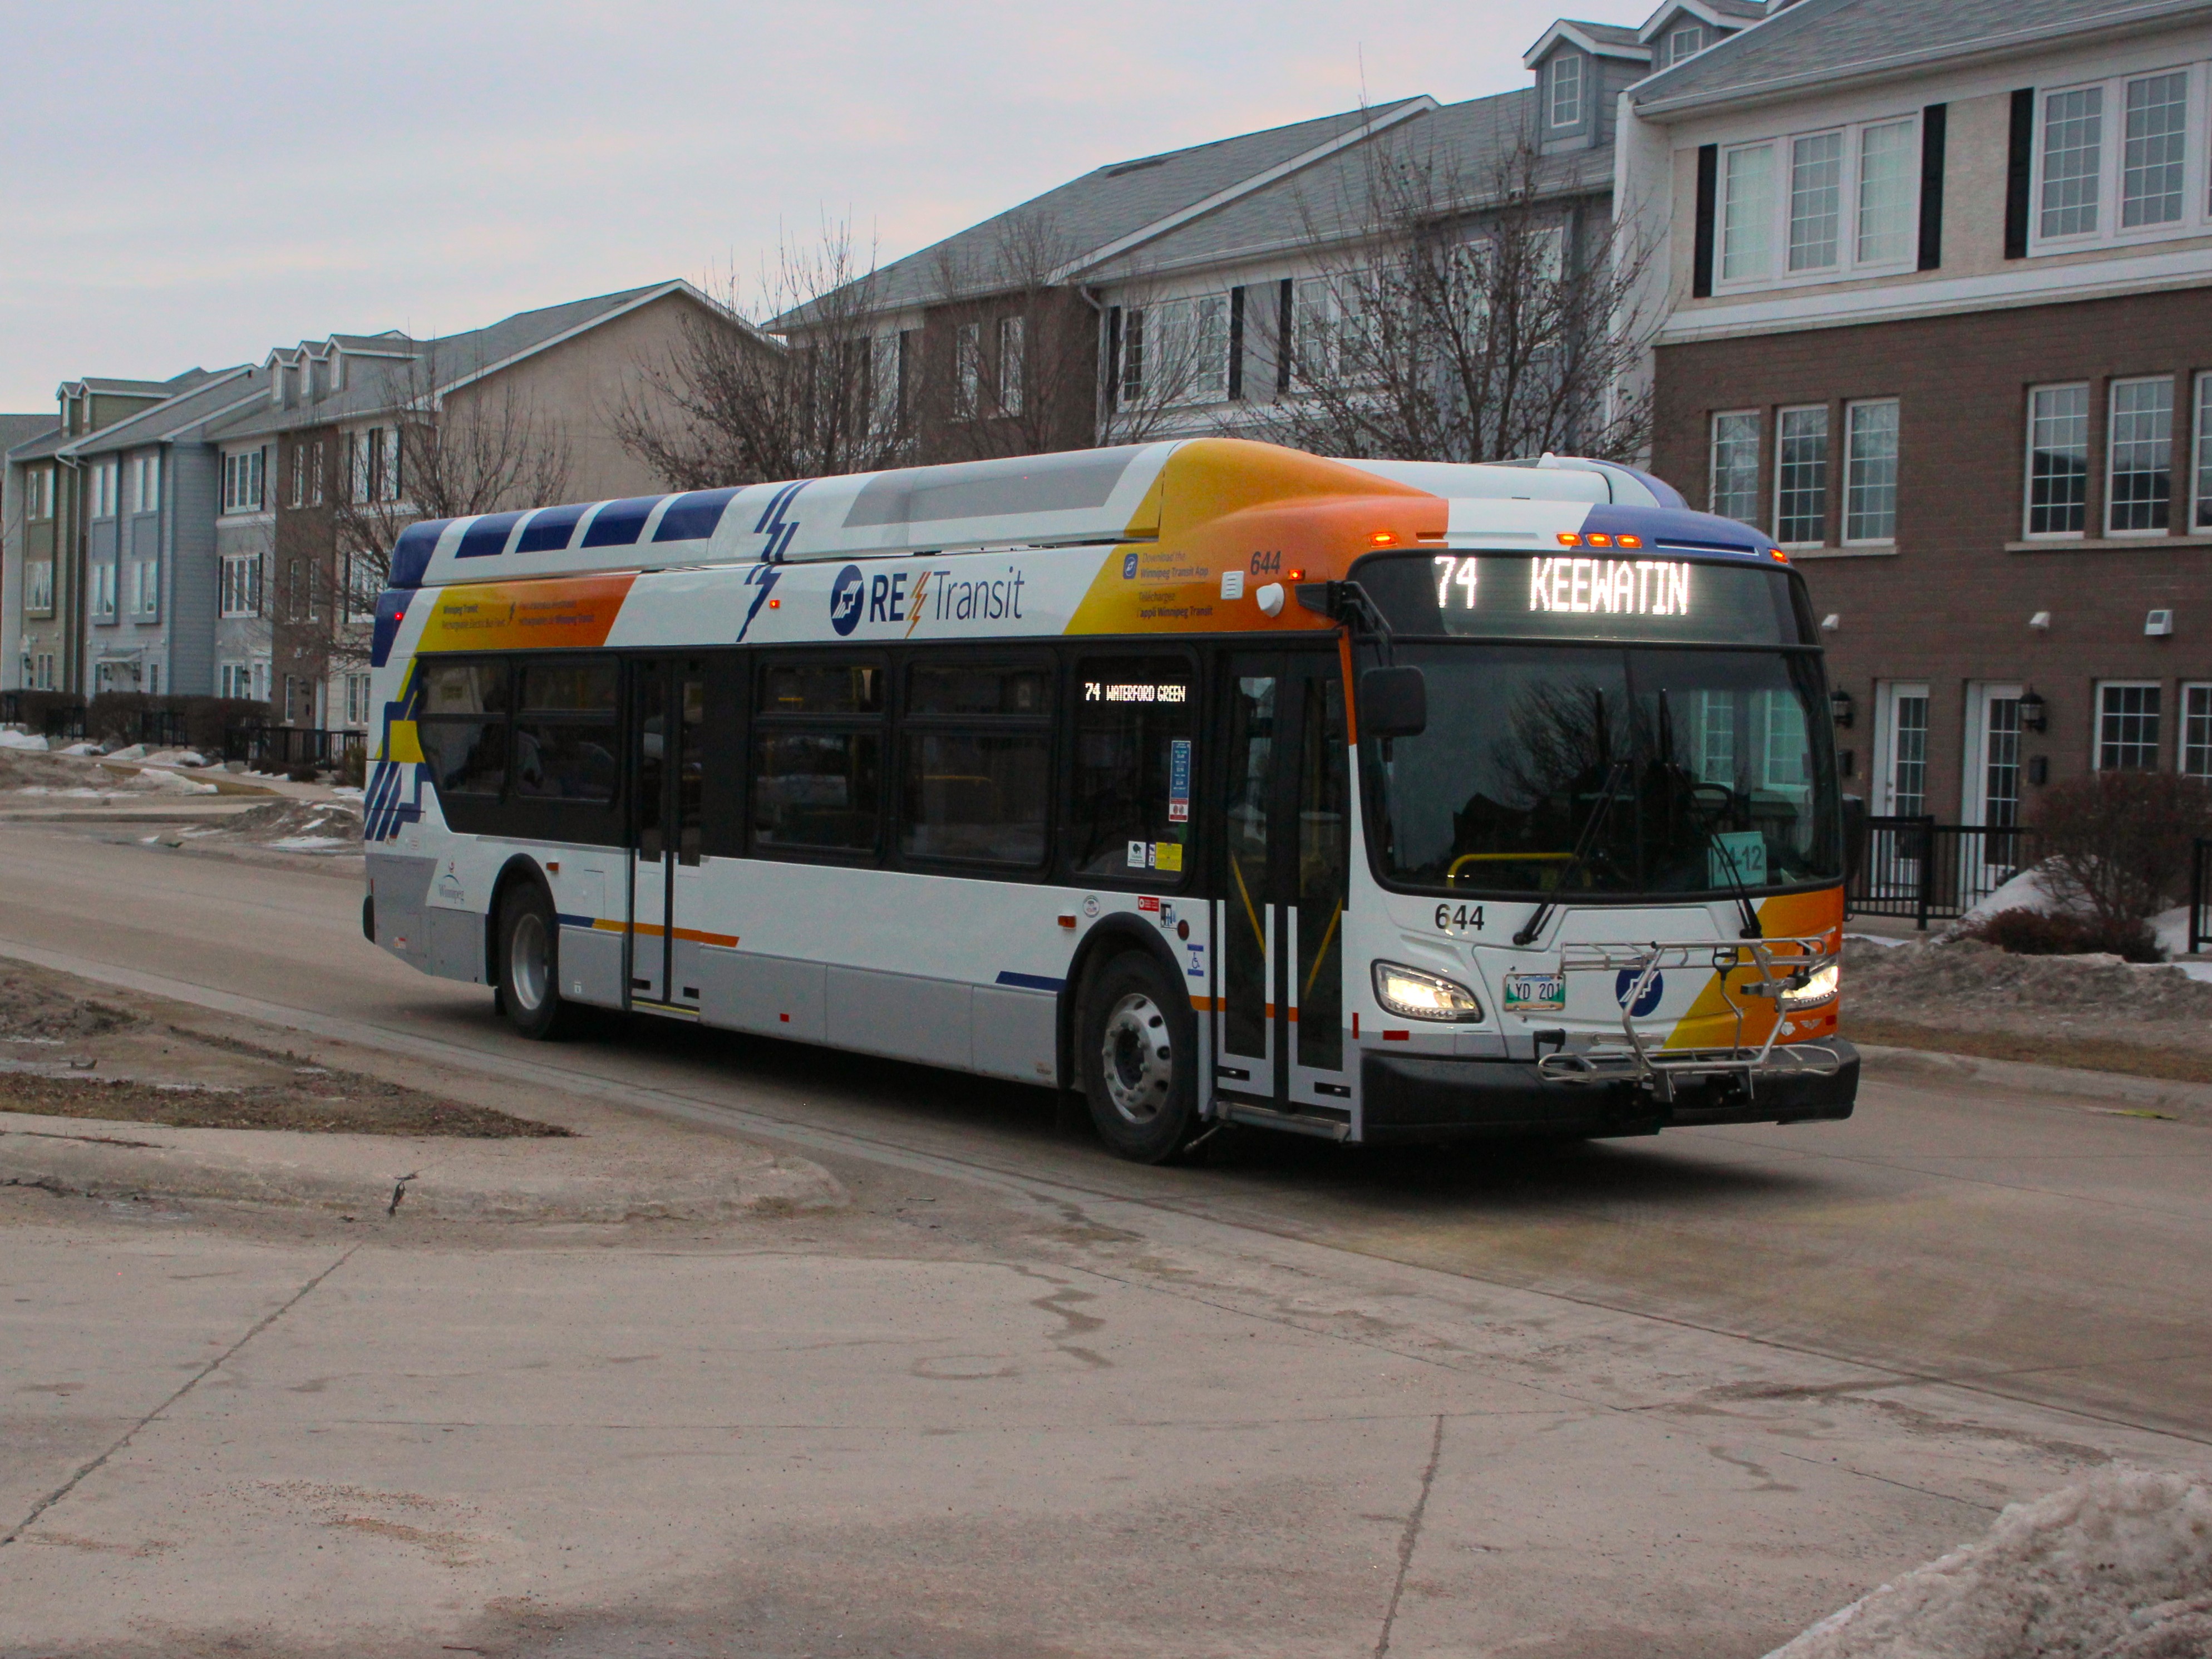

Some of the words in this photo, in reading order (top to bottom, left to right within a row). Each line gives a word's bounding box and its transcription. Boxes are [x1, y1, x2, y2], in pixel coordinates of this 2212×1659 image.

[1140, 568, 1170, 580] Winnipeg
[1171, 566, 1194, 577] Transit
[1195, 566, 1209, 578] App
[1250, 550, 1282, 575] 644
[869, 573, 908, 623] RE
[933, 566, 1025, 621] Transit
[1433, 555, 1477, 609] 74
[1529, 556, 1690, 616] KEEWATIN
[1157, 607, 1189, 619] Winnipeg
[1189, 605, 1213, 616] Transit
[1085, 682, 1101, 701] 74
[1106, 684, 1155, 702] WATERFORD
[1156, 685, 1186, 702] GREEN
[1435, 903, 1485, 931] 644
[1507, 983, 1531, 1000] LYD
[1538, 982, 1560, 1000] 201
